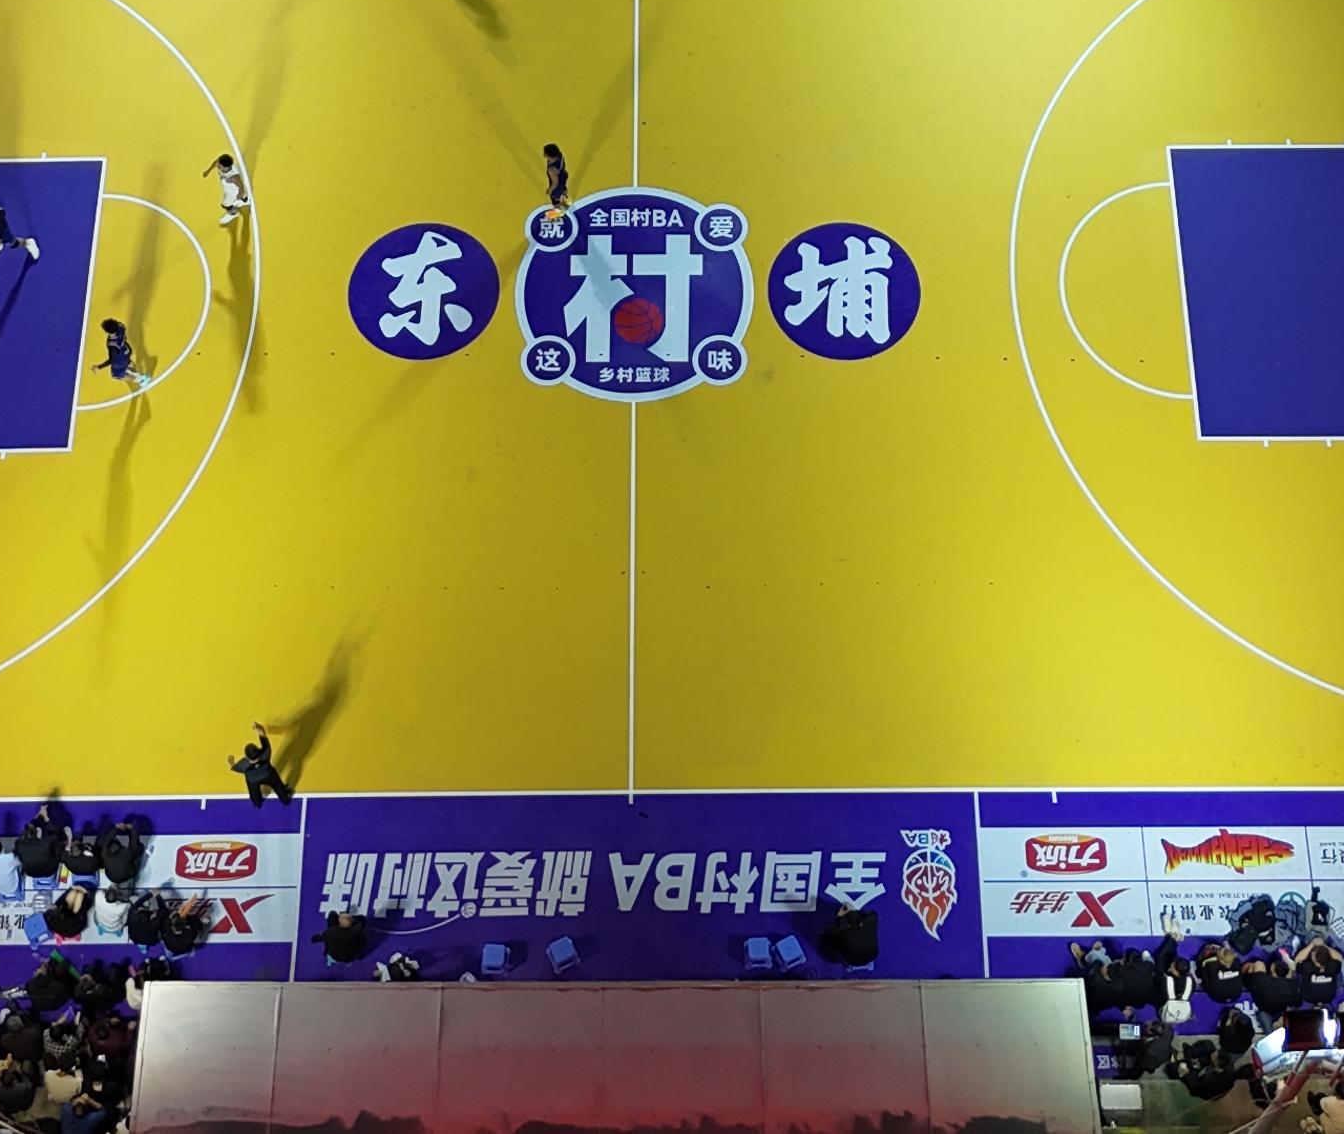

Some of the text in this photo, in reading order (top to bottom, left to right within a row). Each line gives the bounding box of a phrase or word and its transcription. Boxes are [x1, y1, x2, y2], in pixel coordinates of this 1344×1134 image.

[588, 207, 684, 229] 全国村BA
[599, 367, 671, 384] 乡村篮球
[183, 847, 252, 877] 力诚
[1032, 842, 1100, 870] 力诚
[319, 849, 888, 918] 就爱这村味 全国村BA
[1009, 891, 1073, 915] 特步
